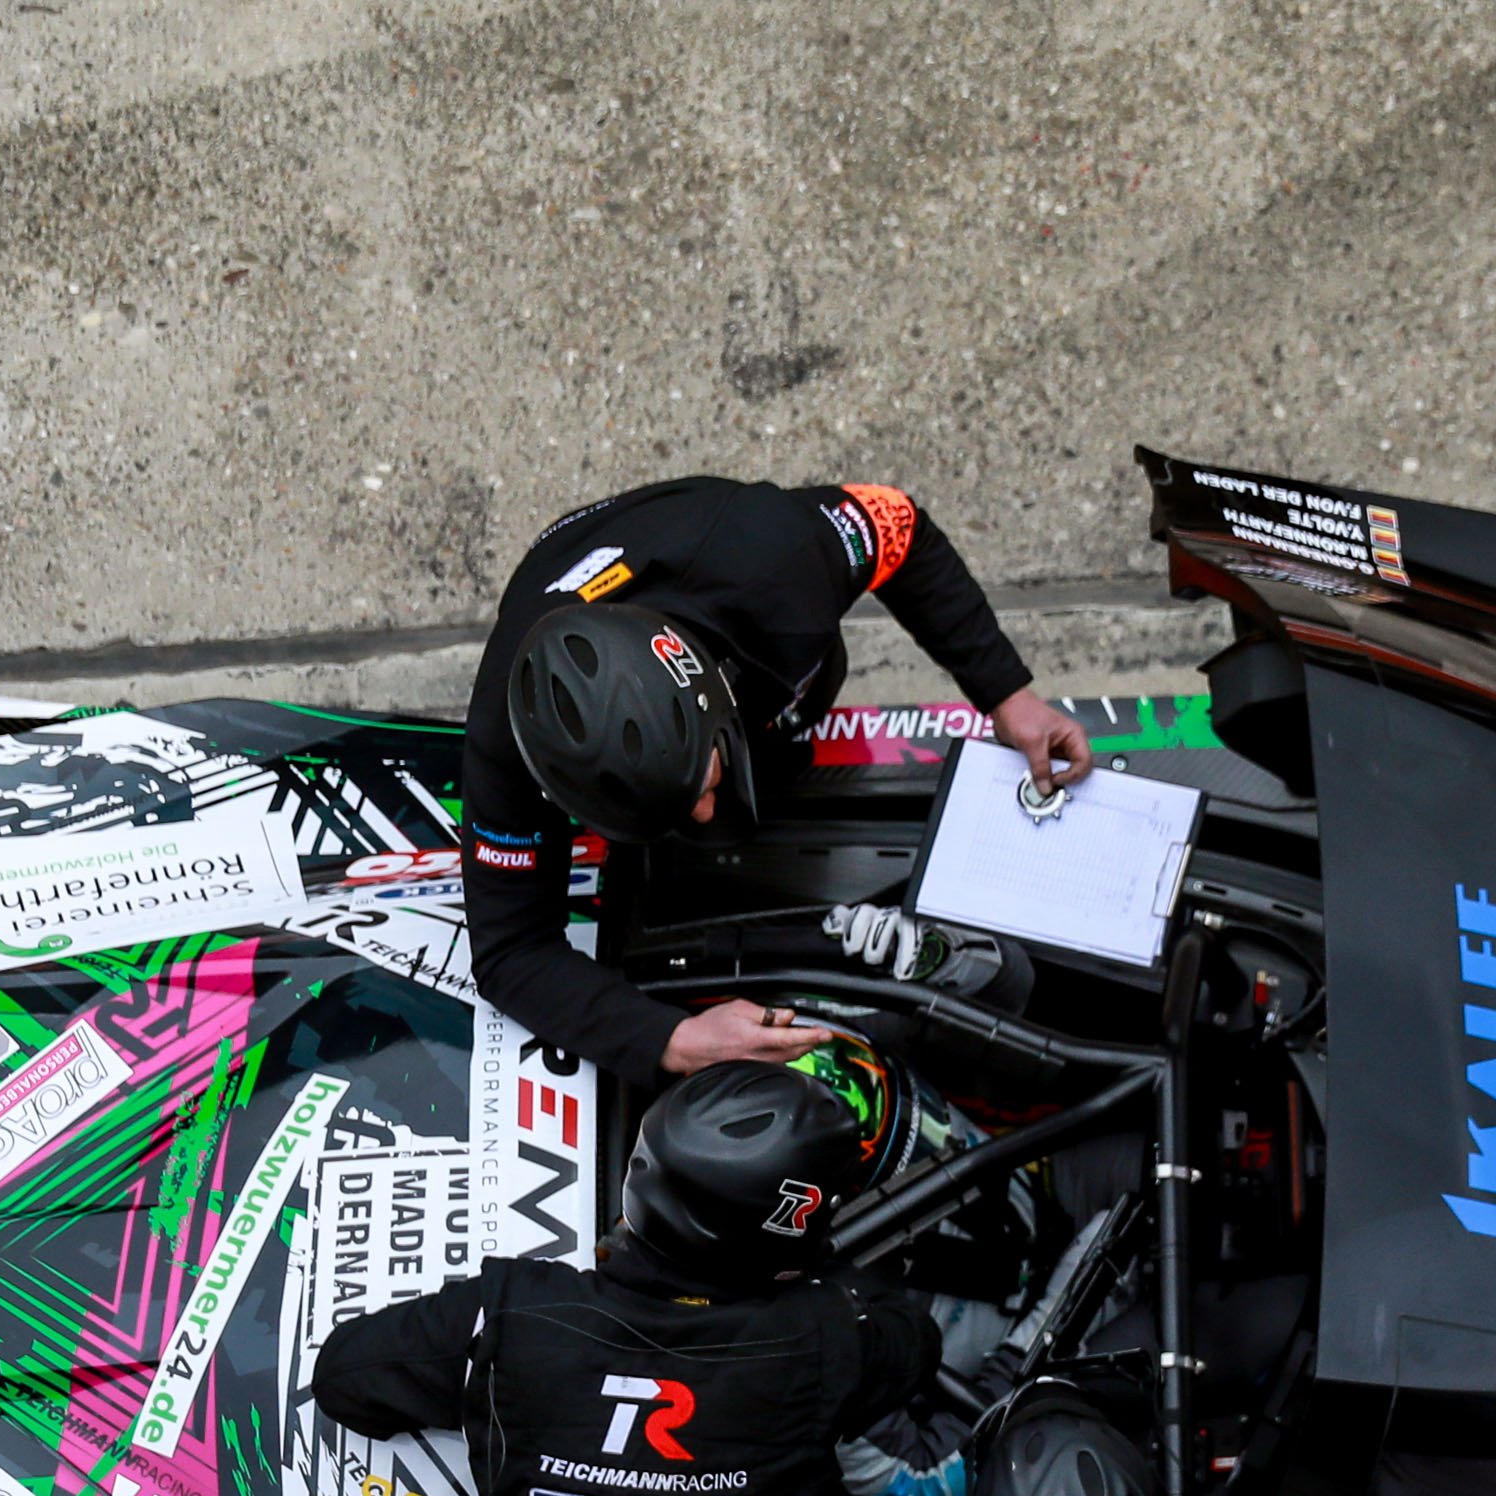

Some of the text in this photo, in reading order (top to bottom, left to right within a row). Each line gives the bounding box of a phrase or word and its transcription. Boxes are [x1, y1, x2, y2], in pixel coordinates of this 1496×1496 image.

[1261, 483, 1303, 507] DER
[142, 842, 179, 858] Die
[476, 845, 533, 867] MOTUL
[0, 853, 246, 913] Rönnefarth
[11, 880, 255, 938] Schreinerei
[481, 1009, 504, 1187] PERFORMANCE
[387, 1168, 428, 1277] MADE
[140, 1079, 341, 1444] holzwuermer24.de
[538, 1453, 748, 1492] TEICHMANNRACING
